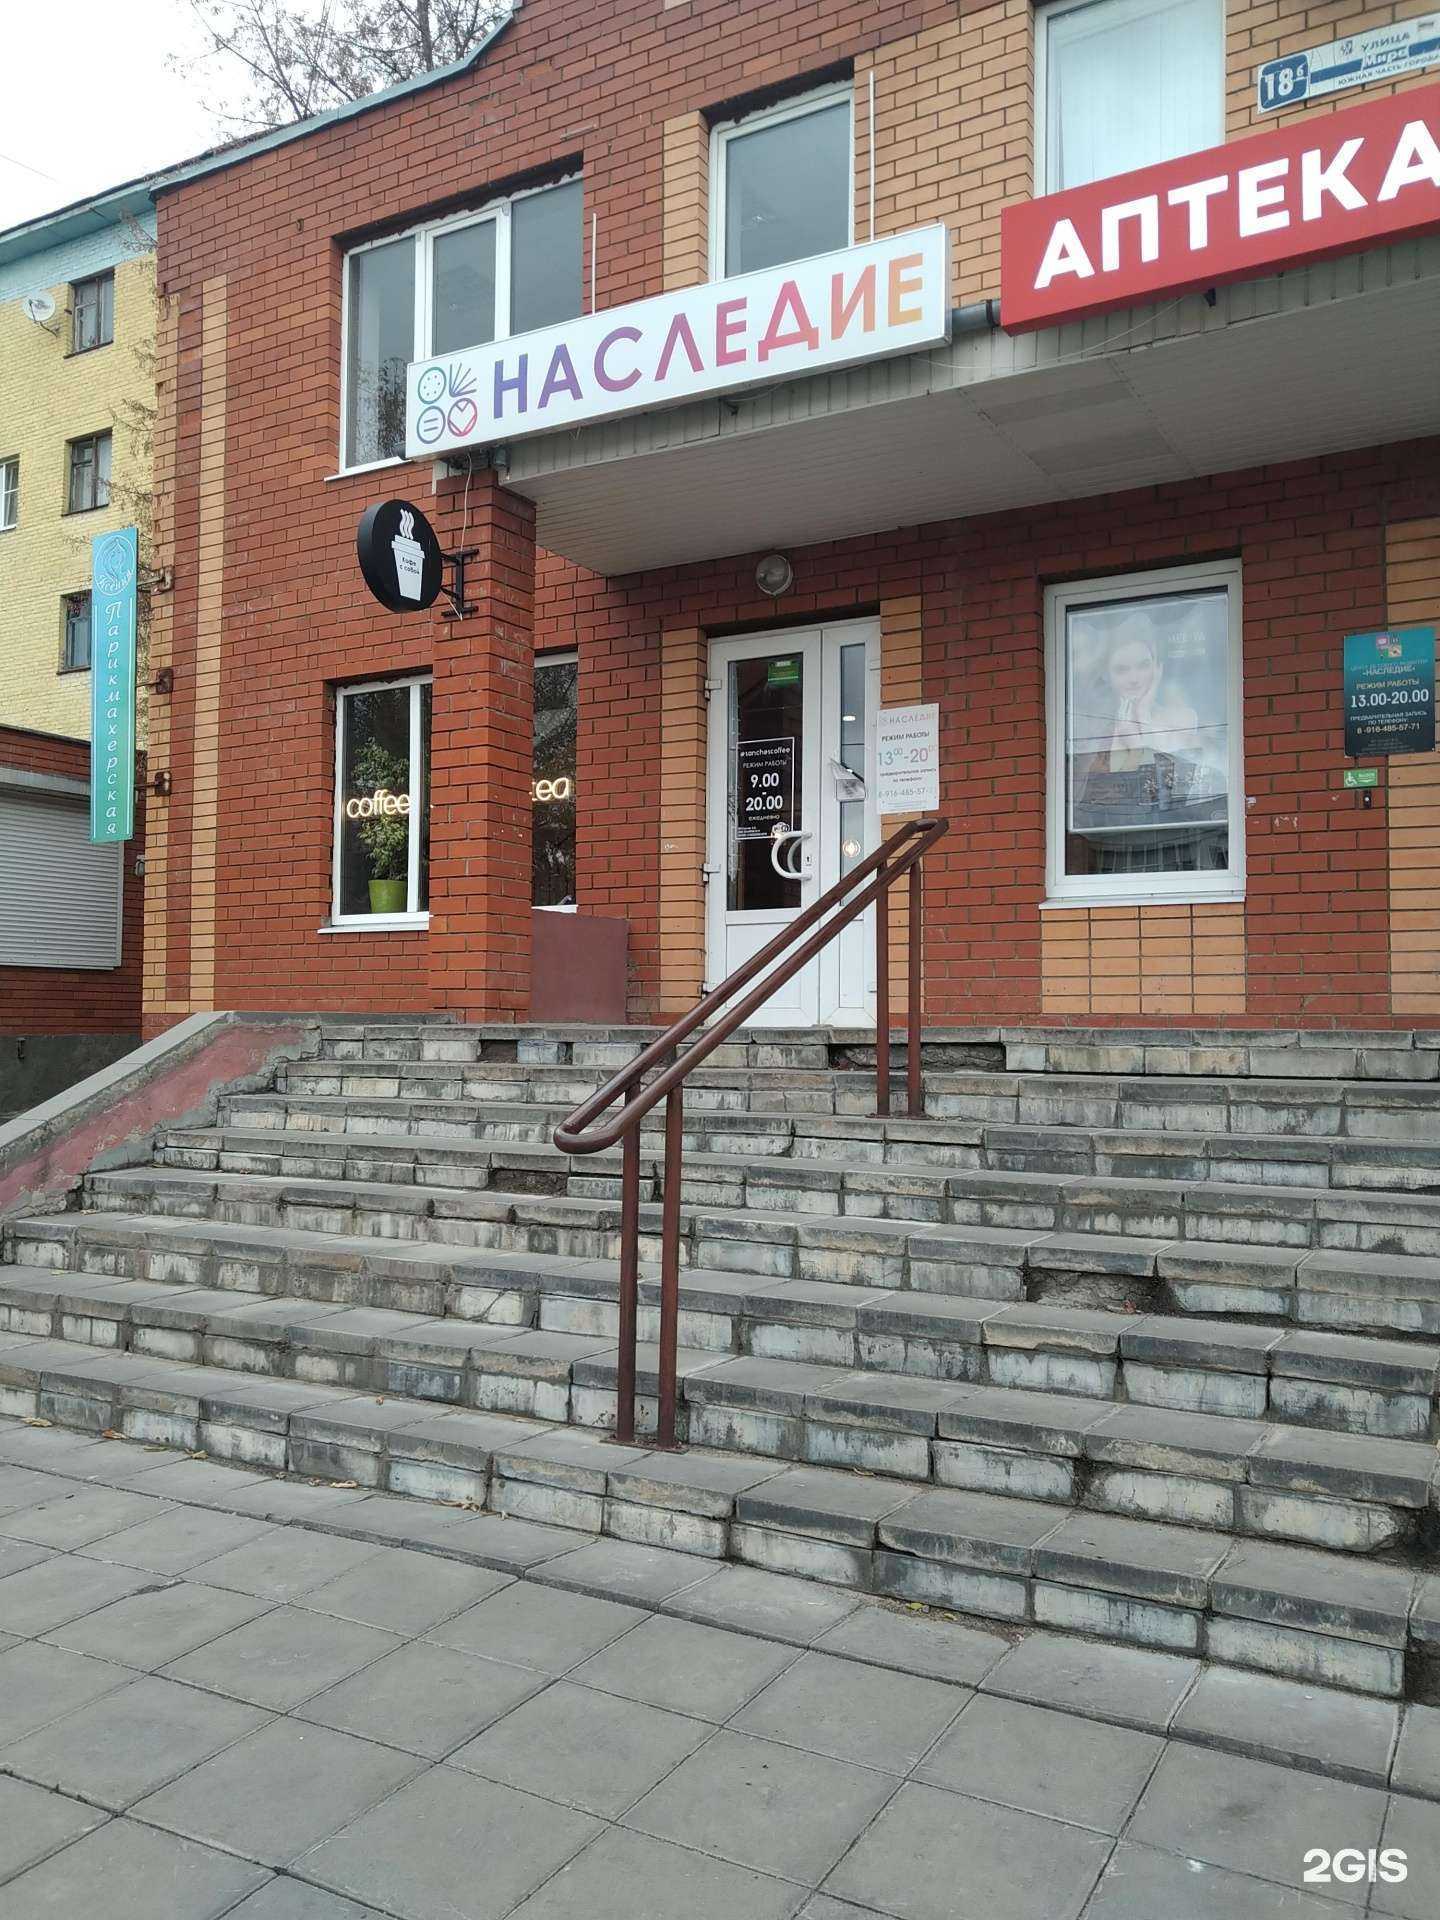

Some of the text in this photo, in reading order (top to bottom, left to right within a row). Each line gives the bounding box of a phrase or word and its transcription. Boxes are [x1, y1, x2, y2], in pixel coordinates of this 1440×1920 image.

[1361, 32, 1410, 51] УЛИЦА
[1033, 119, 1440, 290] АПТЕКА
[493, 252, 924, 420] НАСЛЕДИЕ
[1356, 679, 1420, 690] РЕЖИМ РАБОТЫ
[1351, 689, 1429, 708] 13.00-20.00
[104, 601, 122, 835] Парикмахерская
[881, 731, 930, 742] РЕЖИМ РАБОТЫ
[750, 772, 780, 789] 9.00
[346, 789, 411, 819] coffee
[745, 795, 783, 812] 20.00
